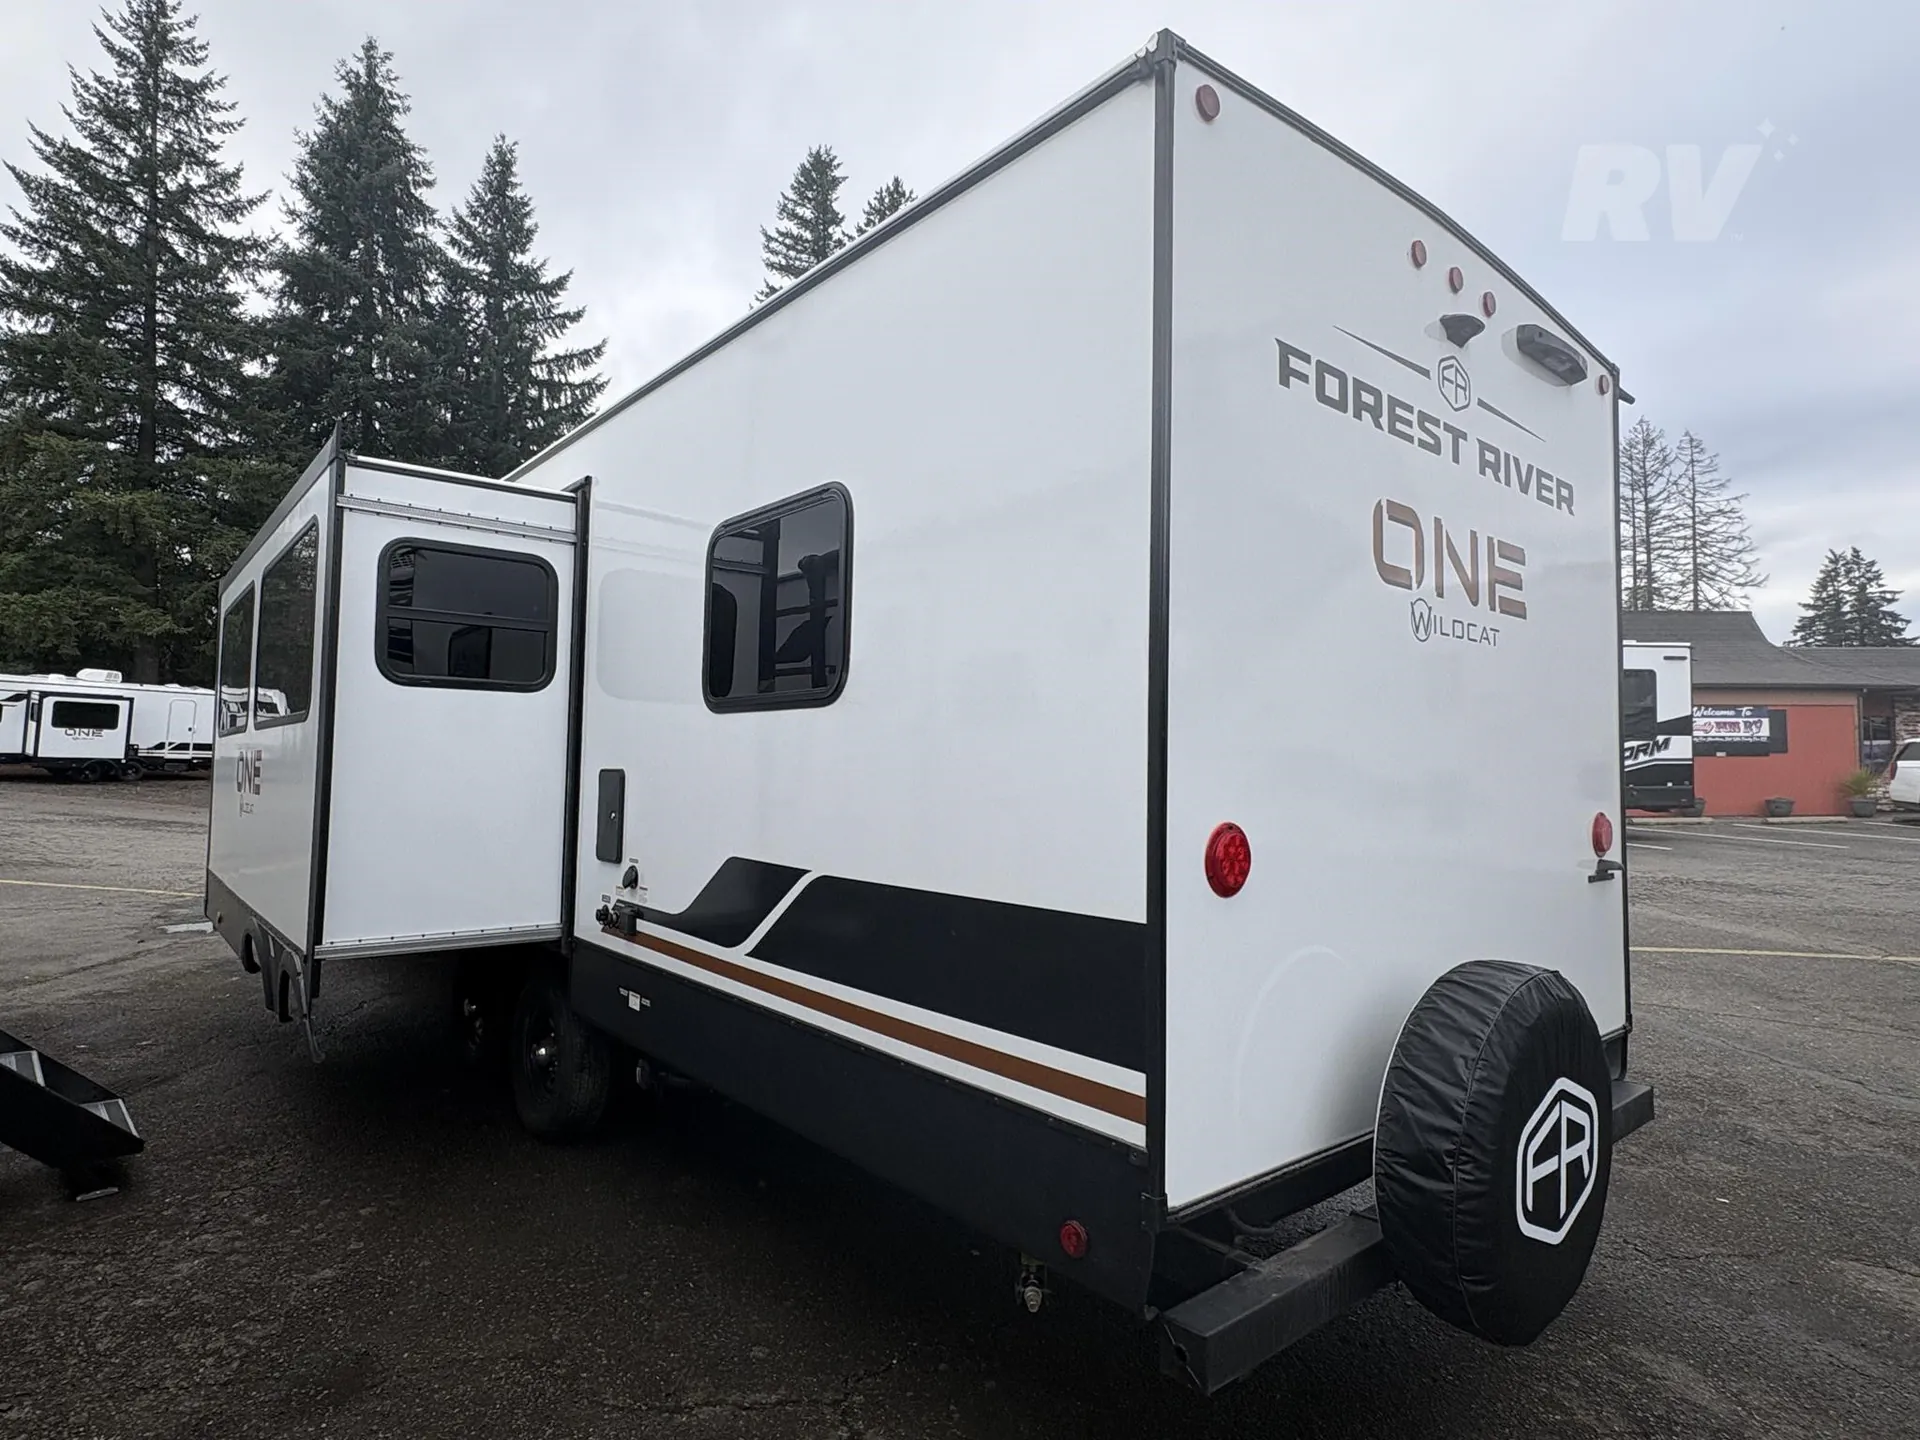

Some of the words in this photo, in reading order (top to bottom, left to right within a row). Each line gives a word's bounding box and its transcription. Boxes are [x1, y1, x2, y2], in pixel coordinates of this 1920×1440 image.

[1275, 337, 1468, 466] FOREST
[1476, 437, 1575, 516] RIVER
[1372, 498, 1527, 620] ONE
[1410, 597, 1500, 647] WILDCAT
[65, 728, 104, 738] ONE
[1692, 706, 1736, 718] Welcome
[1736, 706, 1754, 718] To
[236, 749, 262, 796] ONE
